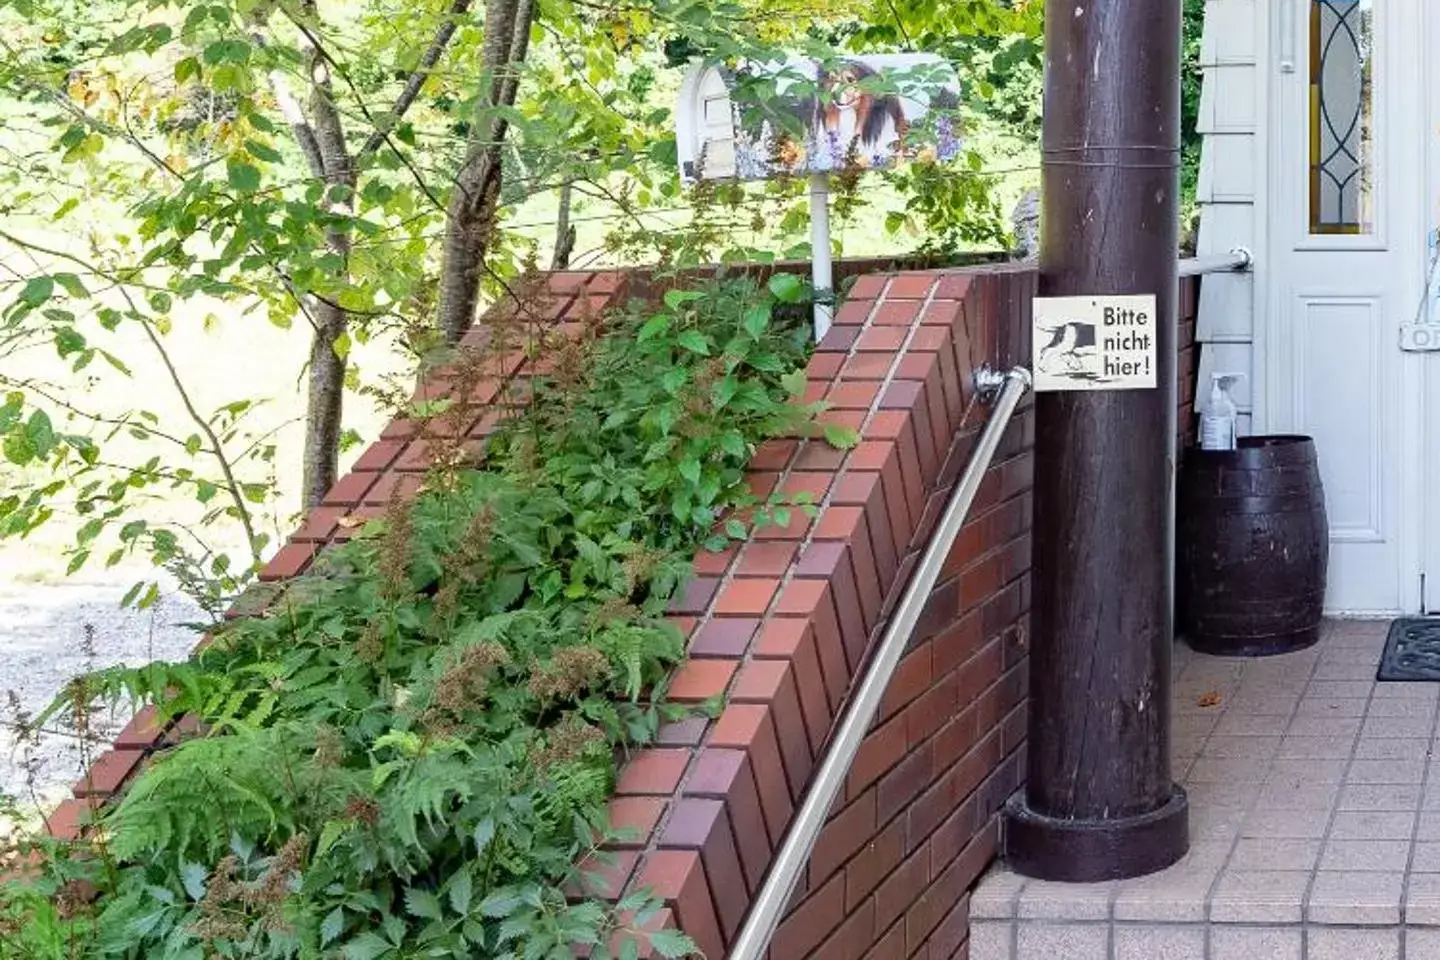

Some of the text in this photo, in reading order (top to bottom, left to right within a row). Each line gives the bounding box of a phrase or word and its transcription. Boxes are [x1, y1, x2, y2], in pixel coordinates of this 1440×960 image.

[1103, 306, 1148, 326] Bitte
[1103, 329, 1150, 351] nicht
[1103, 355, 1150, 375] hier!
